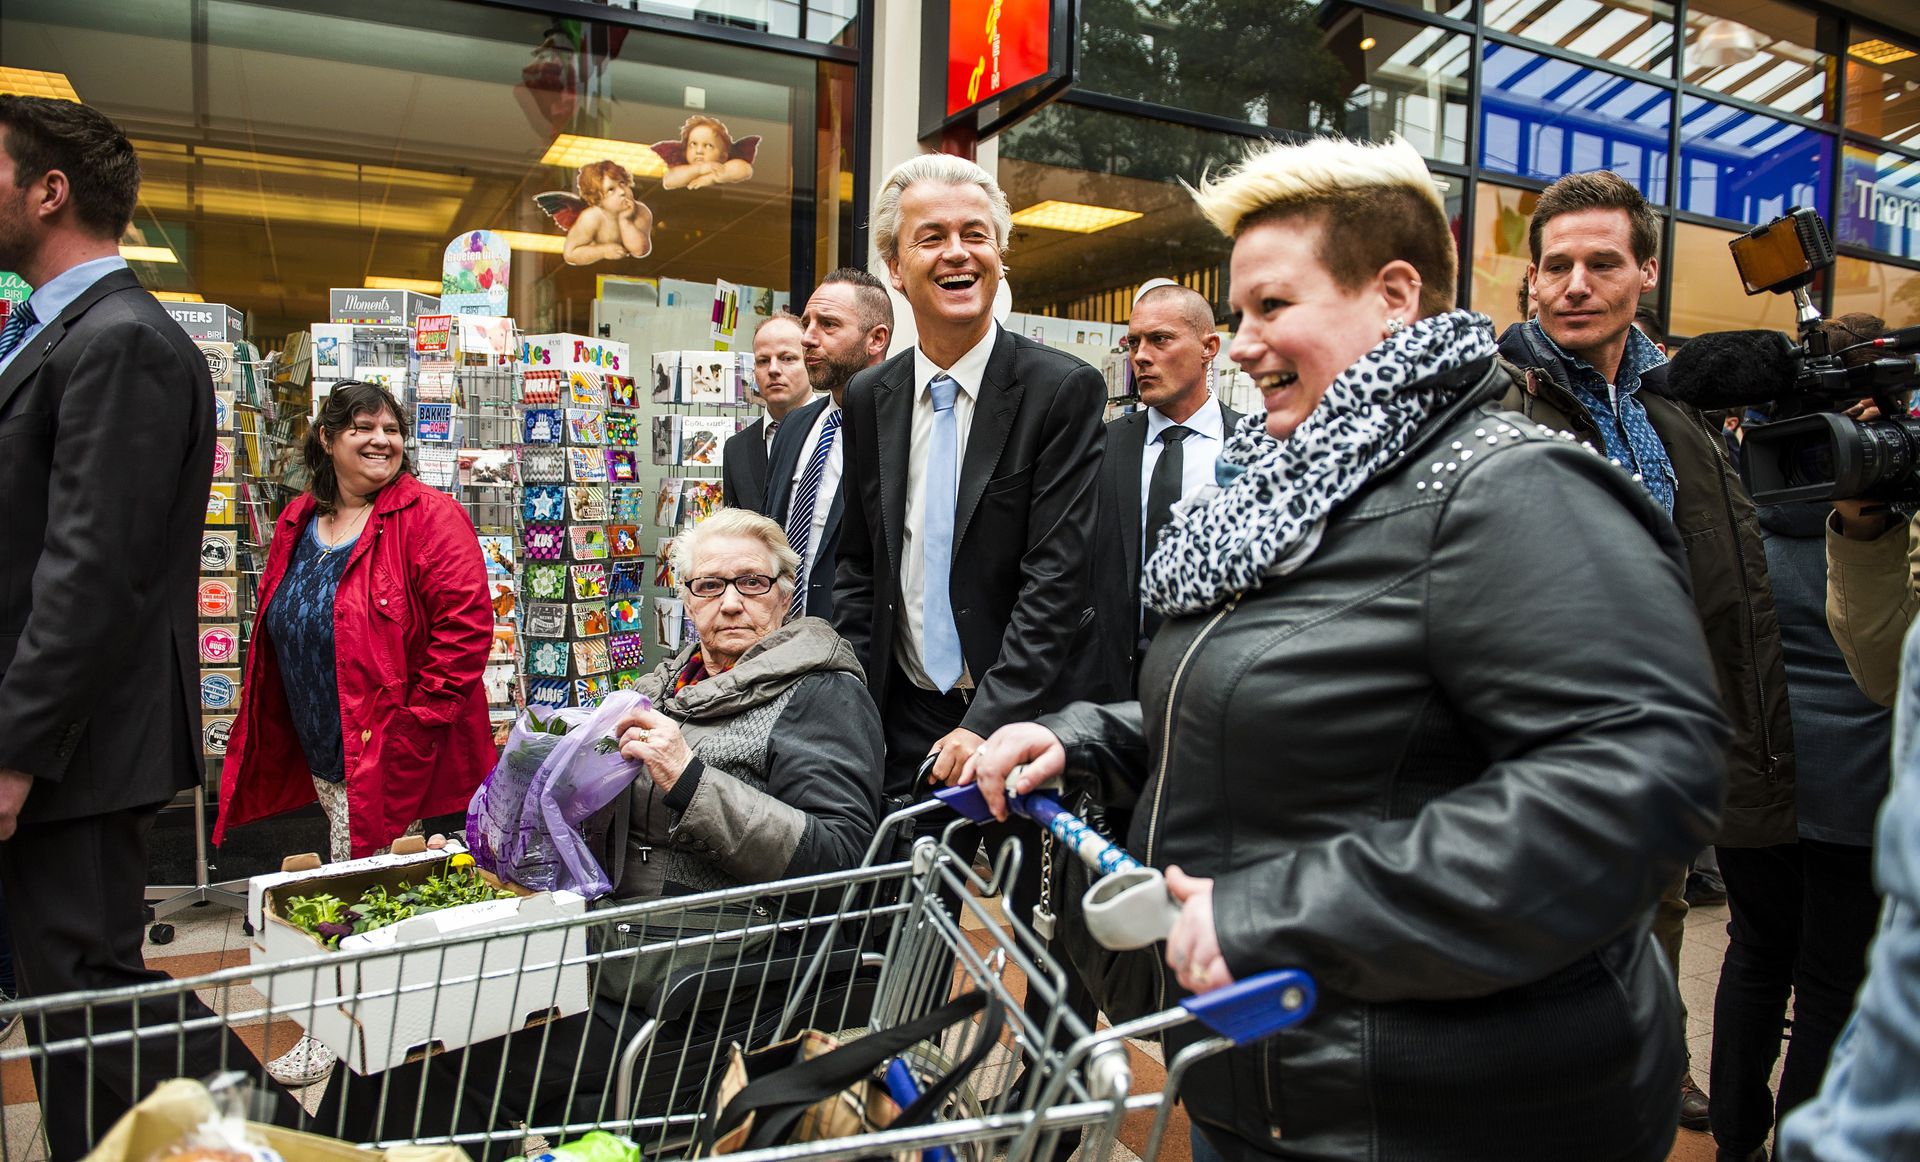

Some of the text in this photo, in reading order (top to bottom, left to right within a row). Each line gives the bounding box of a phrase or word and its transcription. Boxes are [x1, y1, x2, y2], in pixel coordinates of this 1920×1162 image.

[4, 288, 23, 299] BIRI
[345, 294, 390, 311] Moments
[166, 309, 213, 324] NSTERS
[207, 330, 222, 339] BIRI
[419, 405, 450, 421] BAKKIE
[534, 533, 554, 548] KUS
